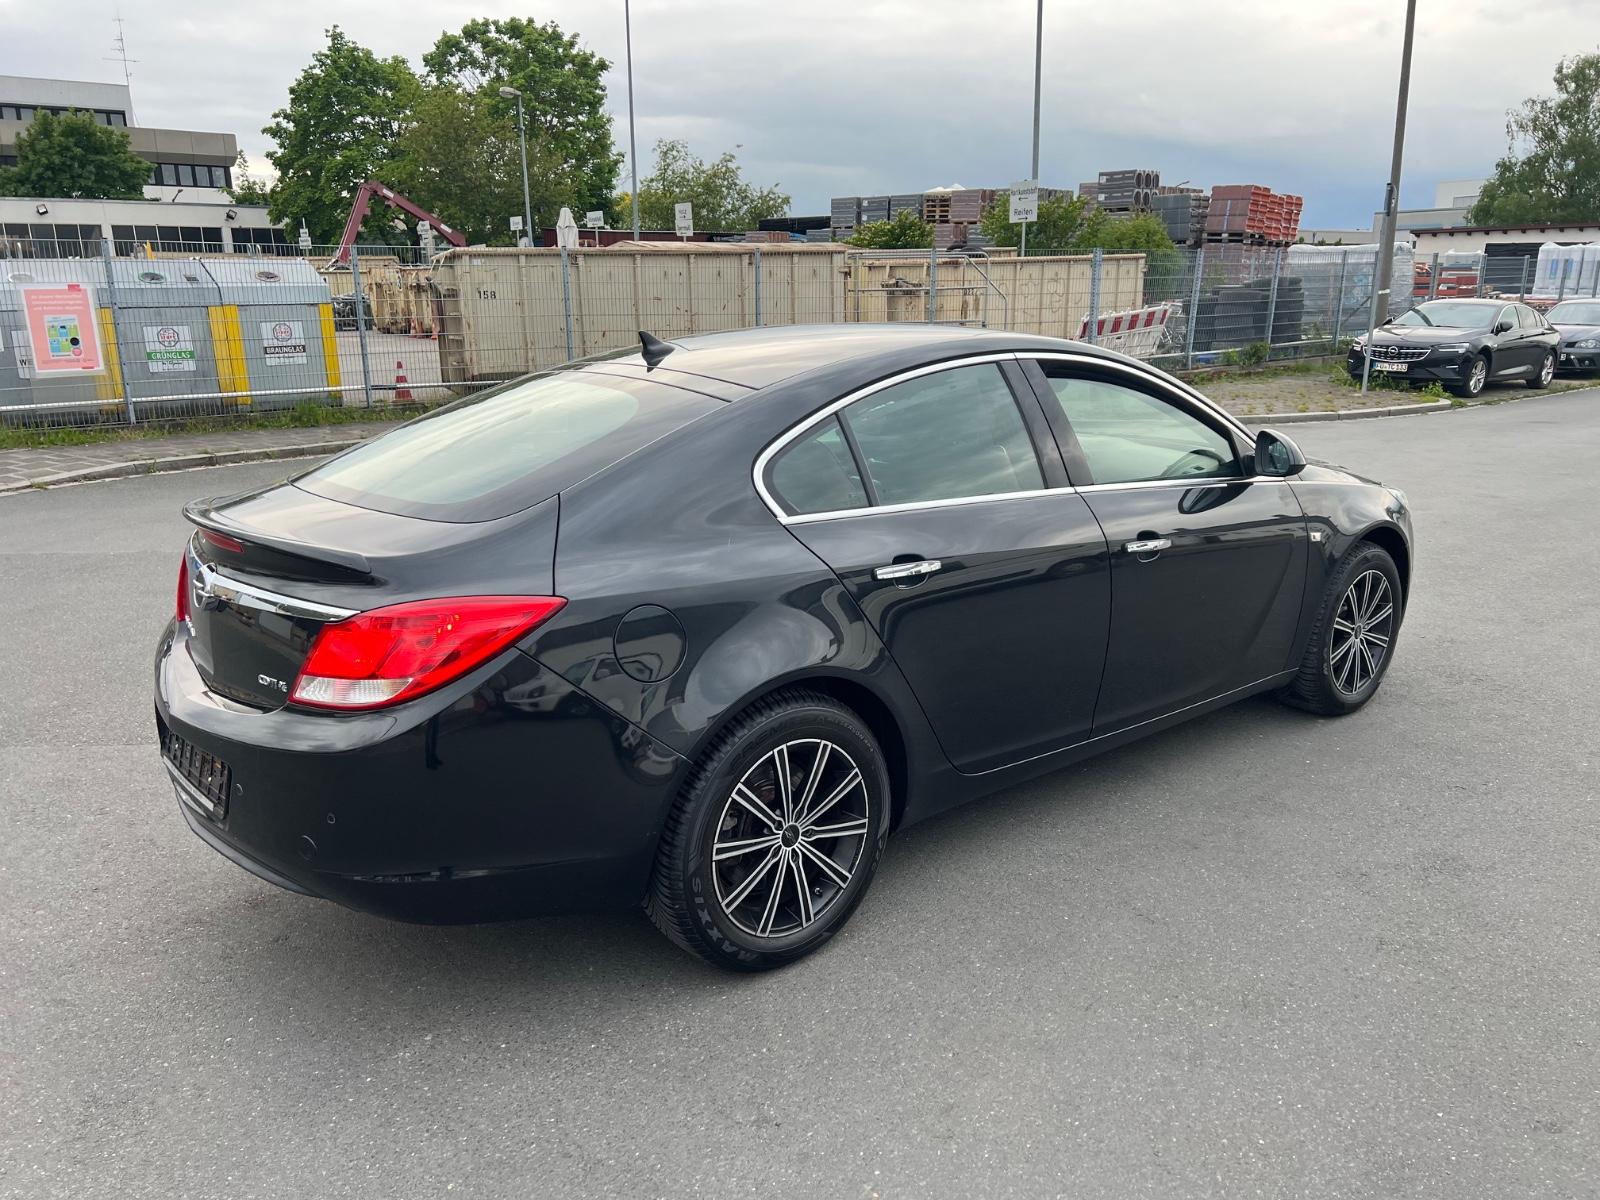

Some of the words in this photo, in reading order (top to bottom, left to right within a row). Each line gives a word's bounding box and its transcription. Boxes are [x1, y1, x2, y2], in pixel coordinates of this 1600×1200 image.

[1013, 208, 1033, 216] Reifen
[477, 290, 496, 300] 158
[266, 346, 304, 354] BRAUNGLAS
[151, 352, 191, 360] GRÜNGLAS
[692, 878, 759, 961] MAXXIS
